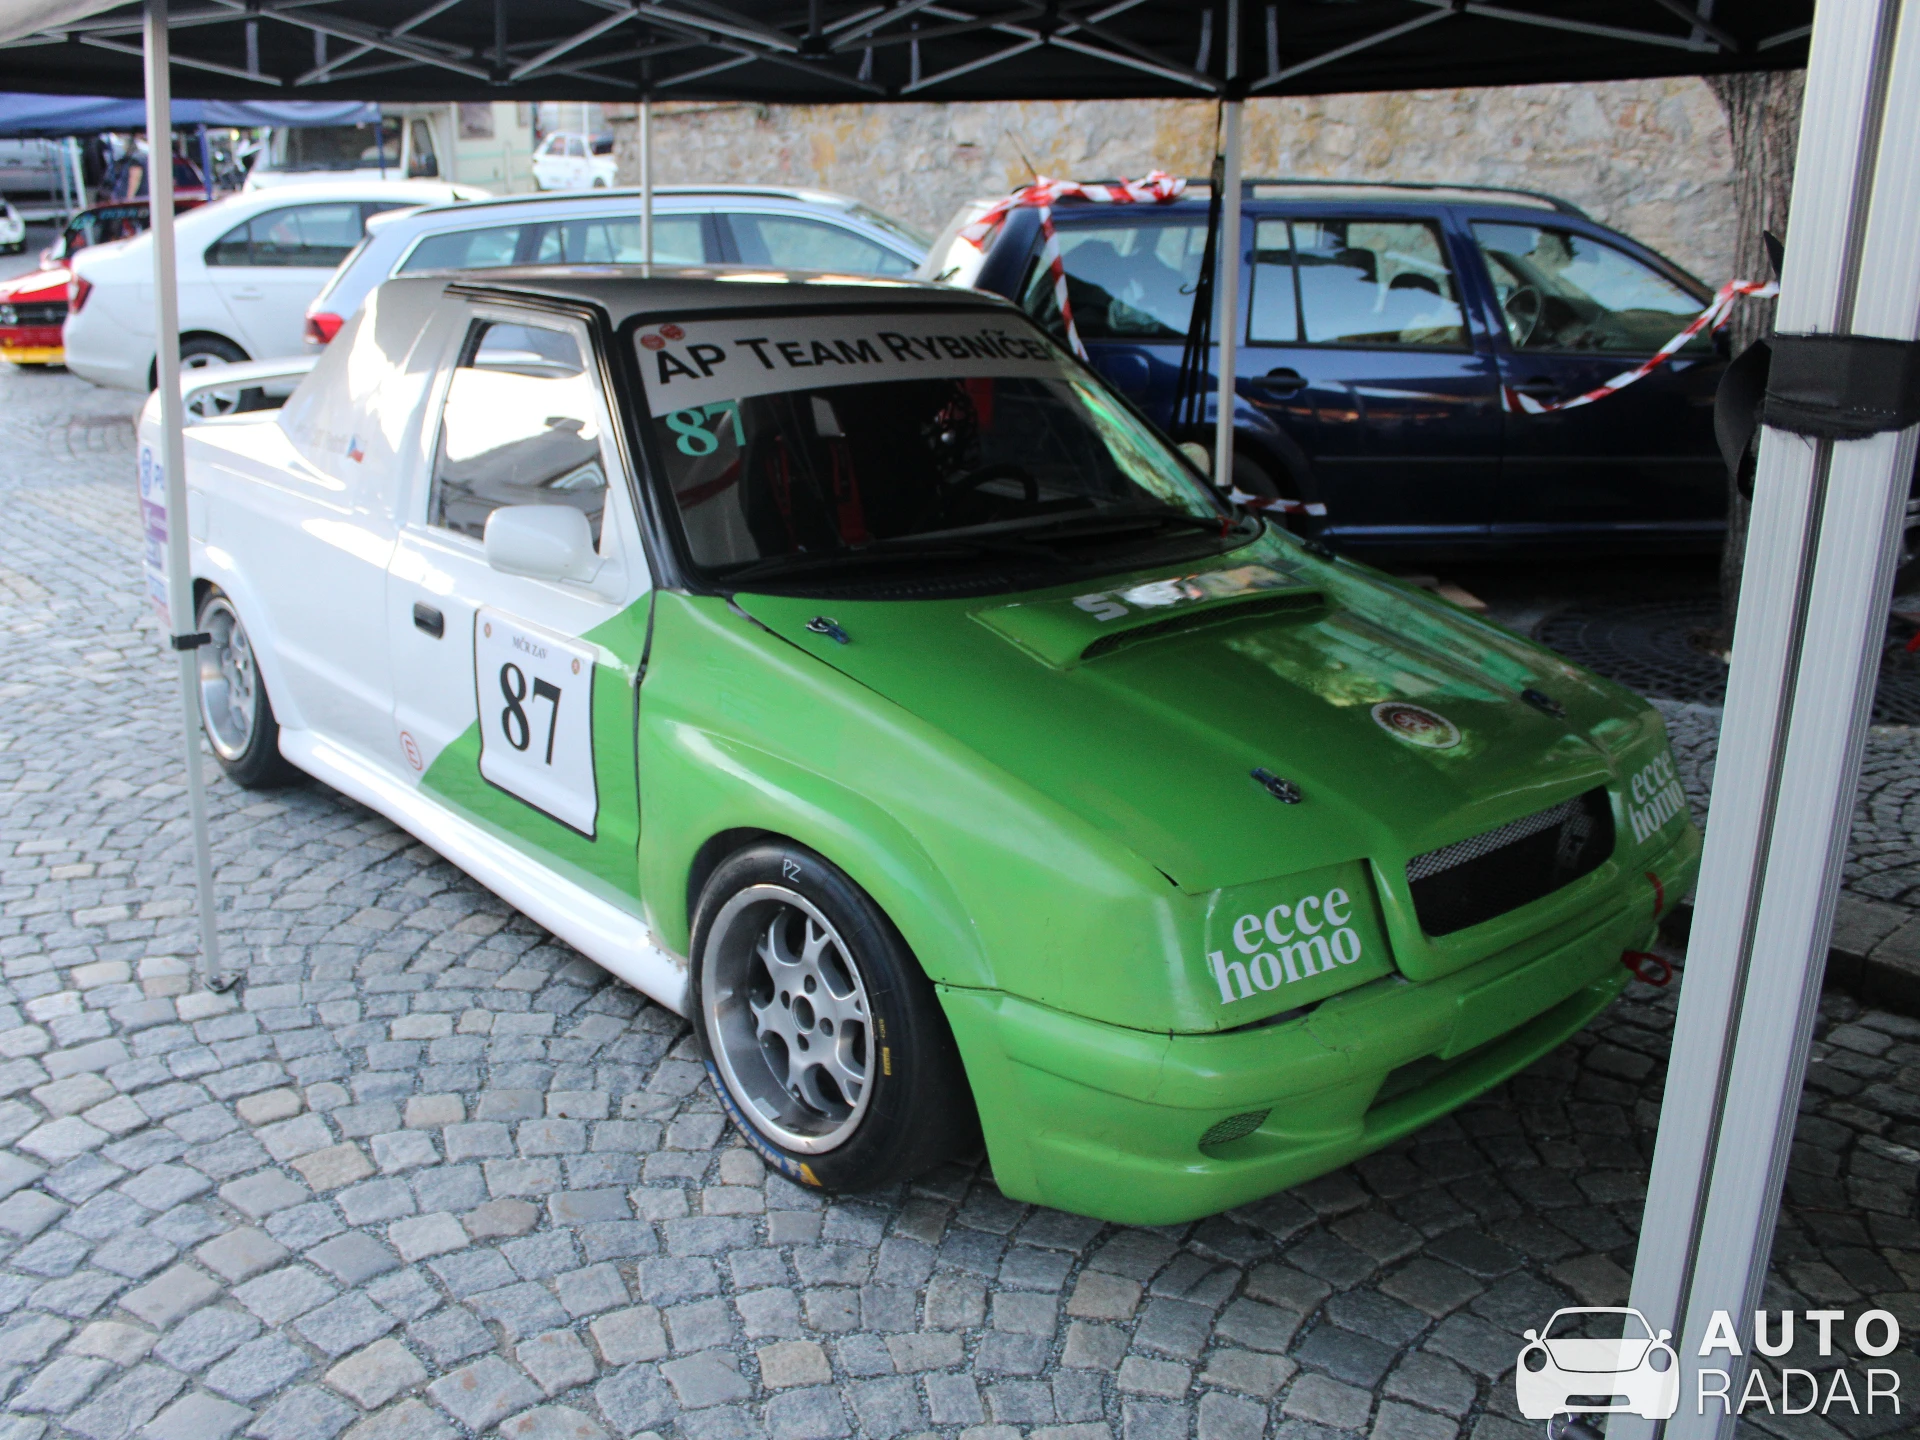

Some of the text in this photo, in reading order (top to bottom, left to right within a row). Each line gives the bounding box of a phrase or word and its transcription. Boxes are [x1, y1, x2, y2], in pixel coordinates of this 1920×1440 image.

[656, 343, 726, 385] AP
[734, 337, 883, 370] TEAM
[665, 399, 746, 457] 87
[499, 662, 562, 766] 87
[1631, 750, 1674, 805] ecce
[1628, 780, 1686, 846] homo
[782, 858, 801, 884] PZ
[1232, 887, 1352, 955] ecce
[1208, 927, 1362, 1005] homo
